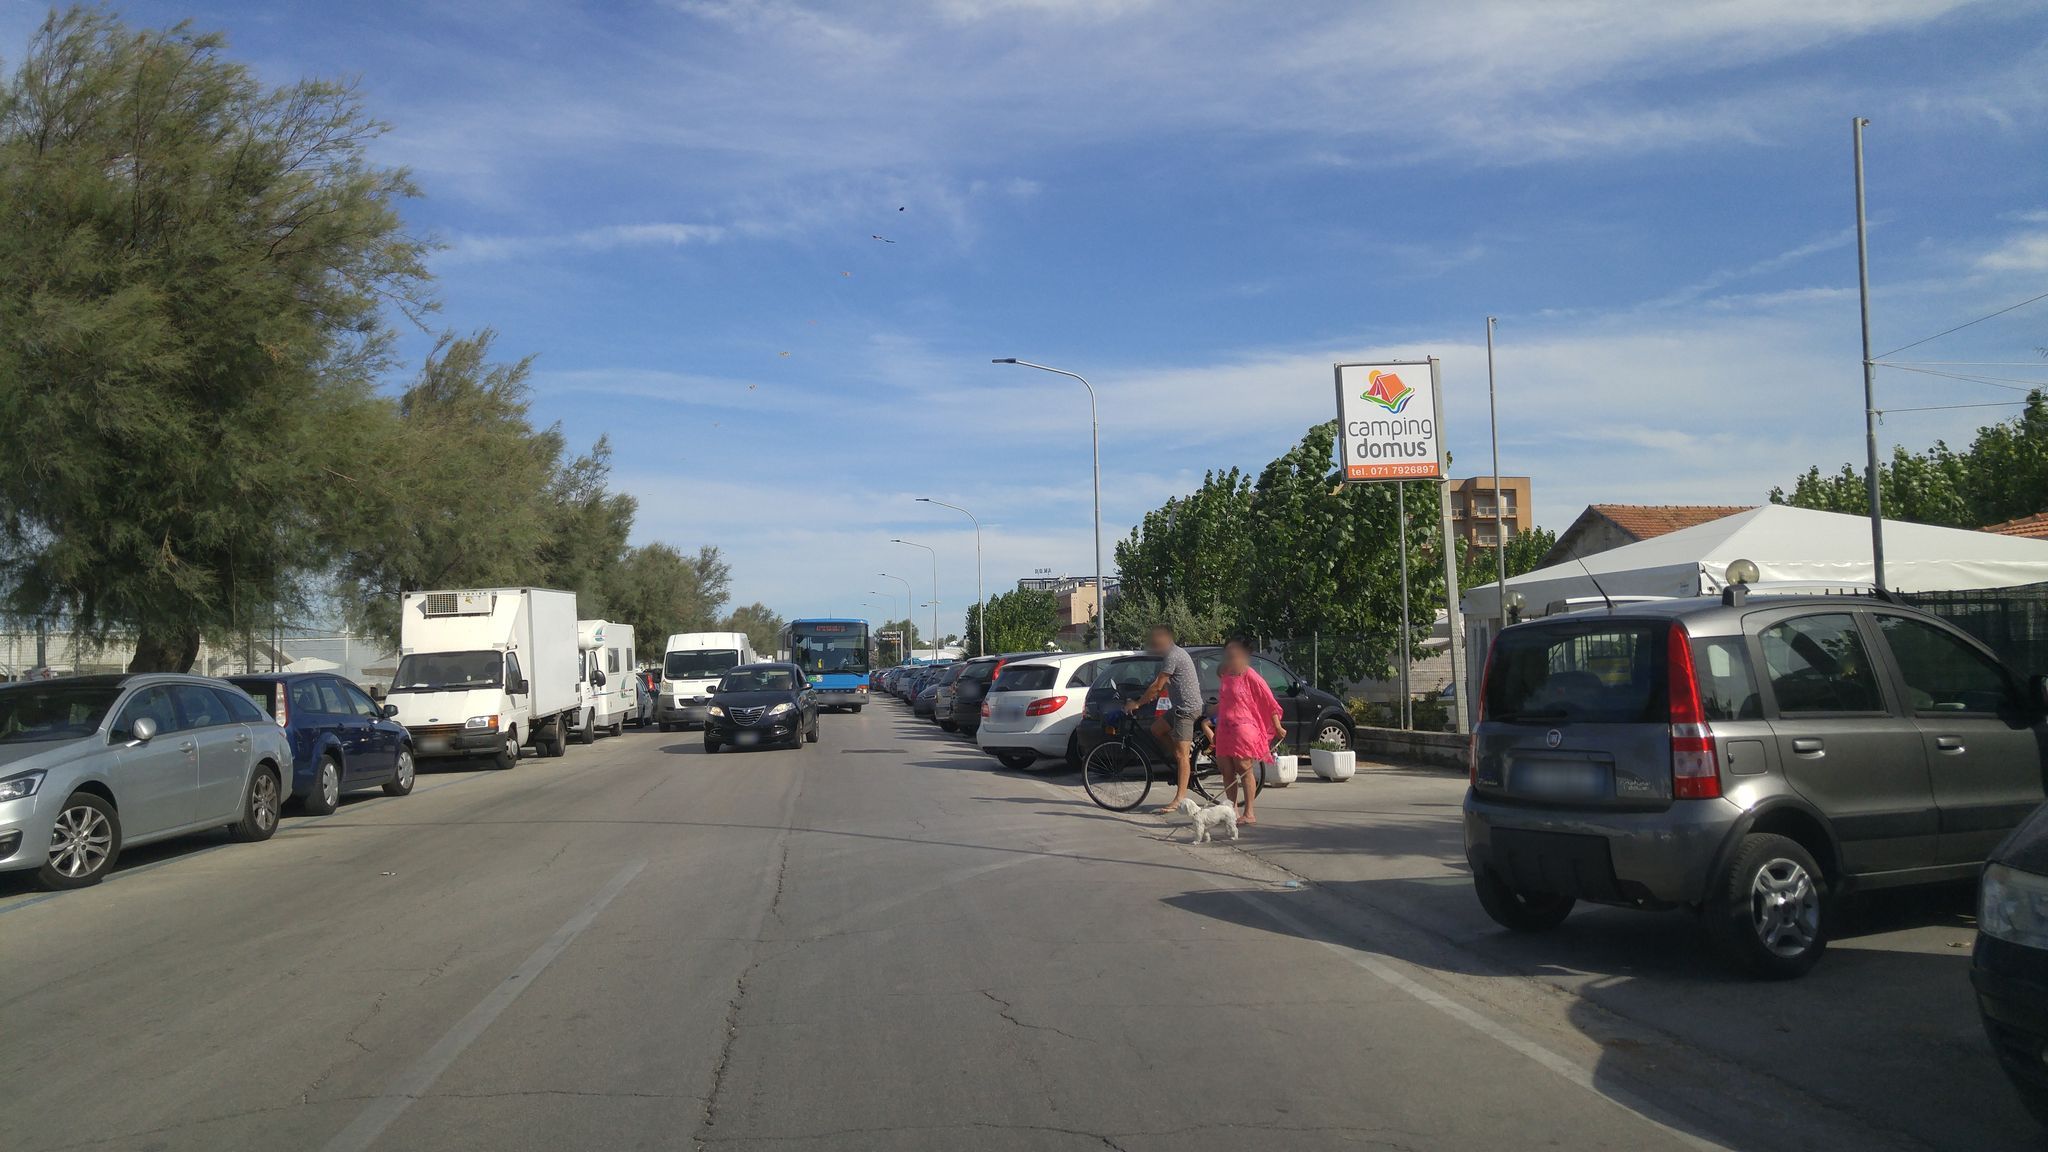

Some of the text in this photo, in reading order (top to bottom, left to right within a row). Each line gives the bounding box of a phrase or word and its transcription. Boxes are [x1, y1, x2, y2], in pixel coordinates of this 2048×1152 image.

[1348, 417, 1433, 440] camping
[1356, 438, 1427, 458] domus
[1351, 465, 1435, 476] tel. 071 7926897
